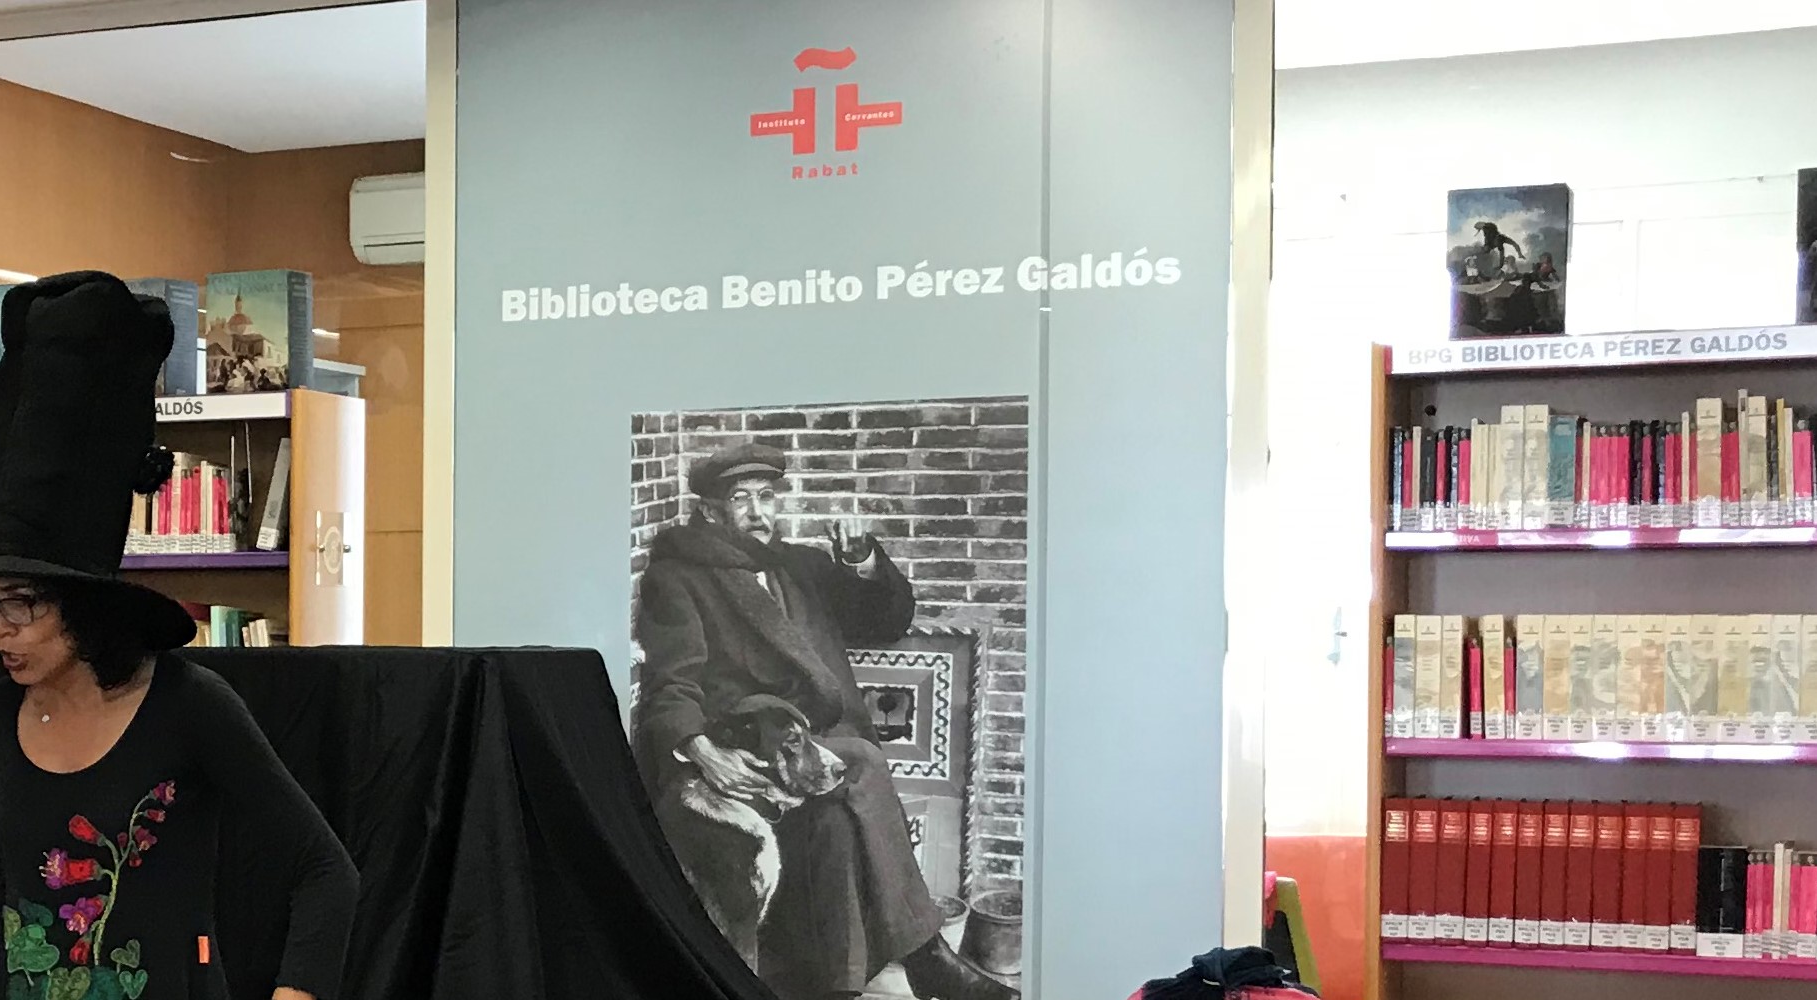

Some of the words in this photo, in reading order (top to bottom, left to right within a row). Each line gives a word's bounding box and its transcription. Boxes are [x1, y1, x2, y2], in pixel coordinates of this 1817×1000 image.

[758, 118, 806, 129] Instituto
[844, 111, 895, 122] Cervantes
[792, 163, 858, 179] Rabat
[501, 283, 709, 322] Biblioteca
[722, 269, 863, 309] Benito
[877, 259, 1005, 300] Pérez
[1017, 247, 1181, 292] Galdós
[1408, 347, 1453, 365] BPG
[1461, 341, 1595, 363] BIBLIOTECA
[1604, 335, 1682, 358] PÉREZ
[1690, 331, 1788, 355] GALDÓS
[155, 398, 204, 416] ALDÓS
